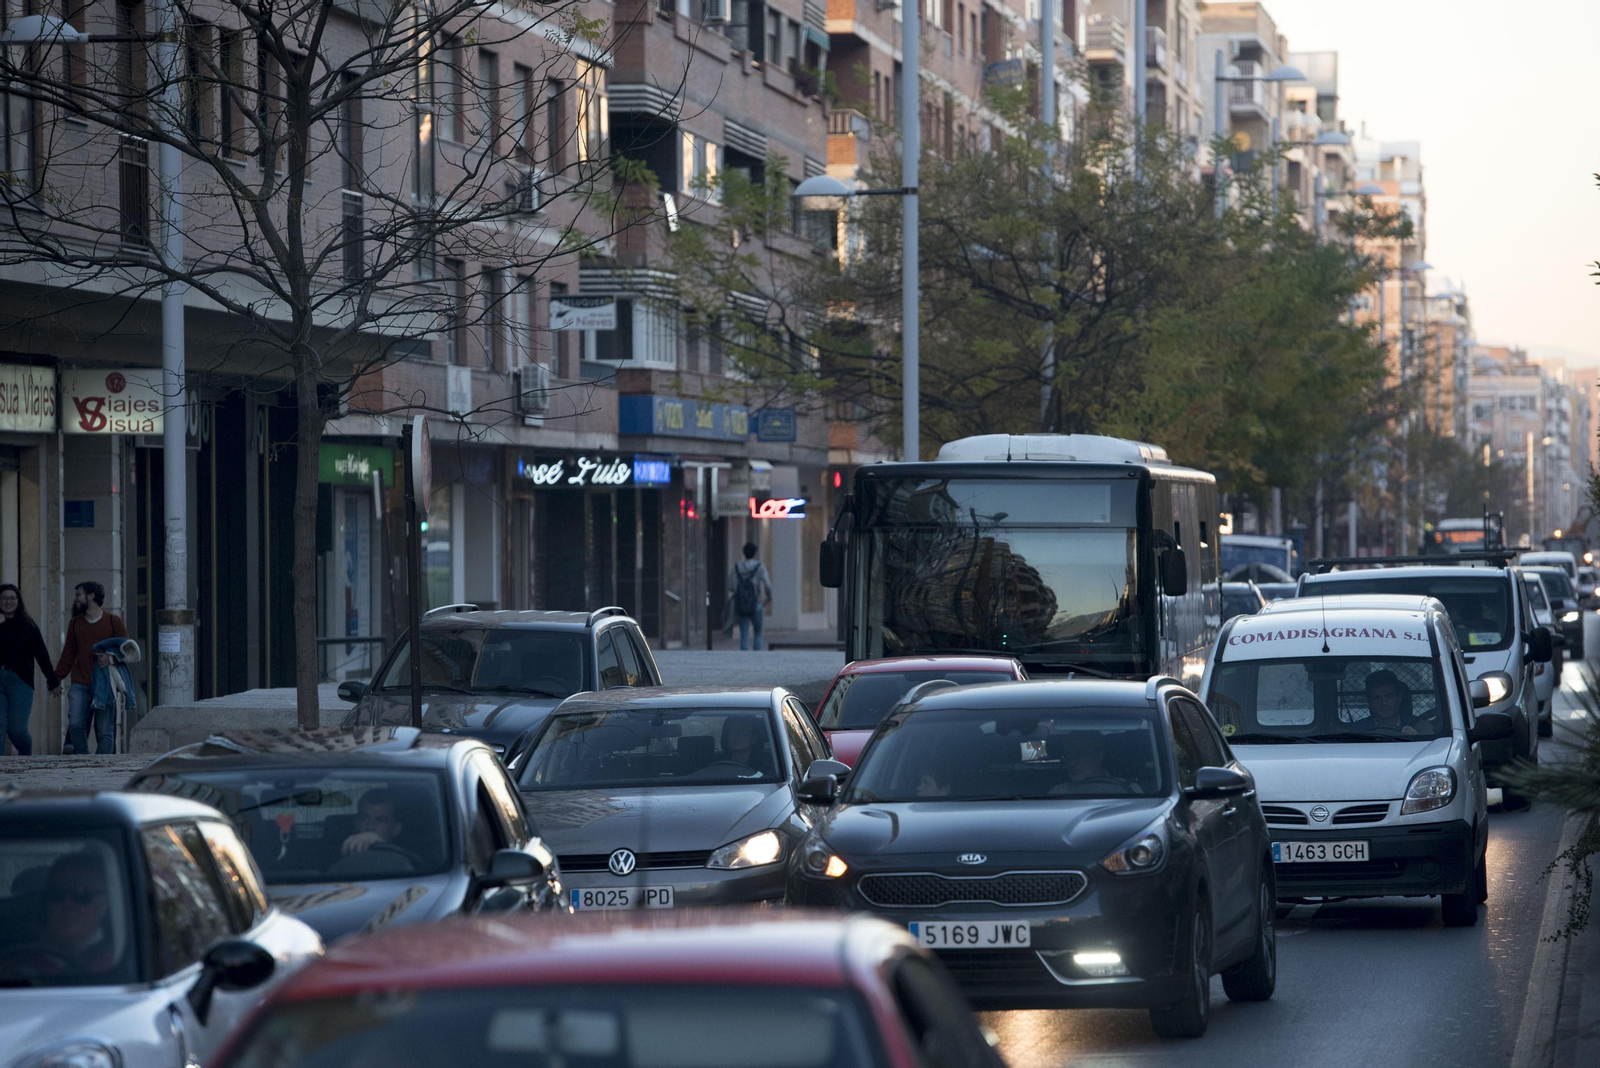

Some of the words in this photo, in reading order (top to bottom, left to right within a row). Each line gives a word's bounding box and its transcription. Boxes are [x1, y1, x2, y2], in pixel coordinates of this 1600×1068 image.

[22, 373, 55, 427] Viajes
[568, 456, 632, 486] Luis
[1228, 627, 1397, 646] COMADISAGRANA
[1403, 631, 1429, 642] S.L.
[961, 853, 983, 862] KIA
[1285, 844, 1327, 860] 1463
[1332, 844, 1365, 860] GCH
[583, 890, 629, 907] 8025
[925, 924, 980, 945] 5169
[987, 924, 1027, 945] JWC
